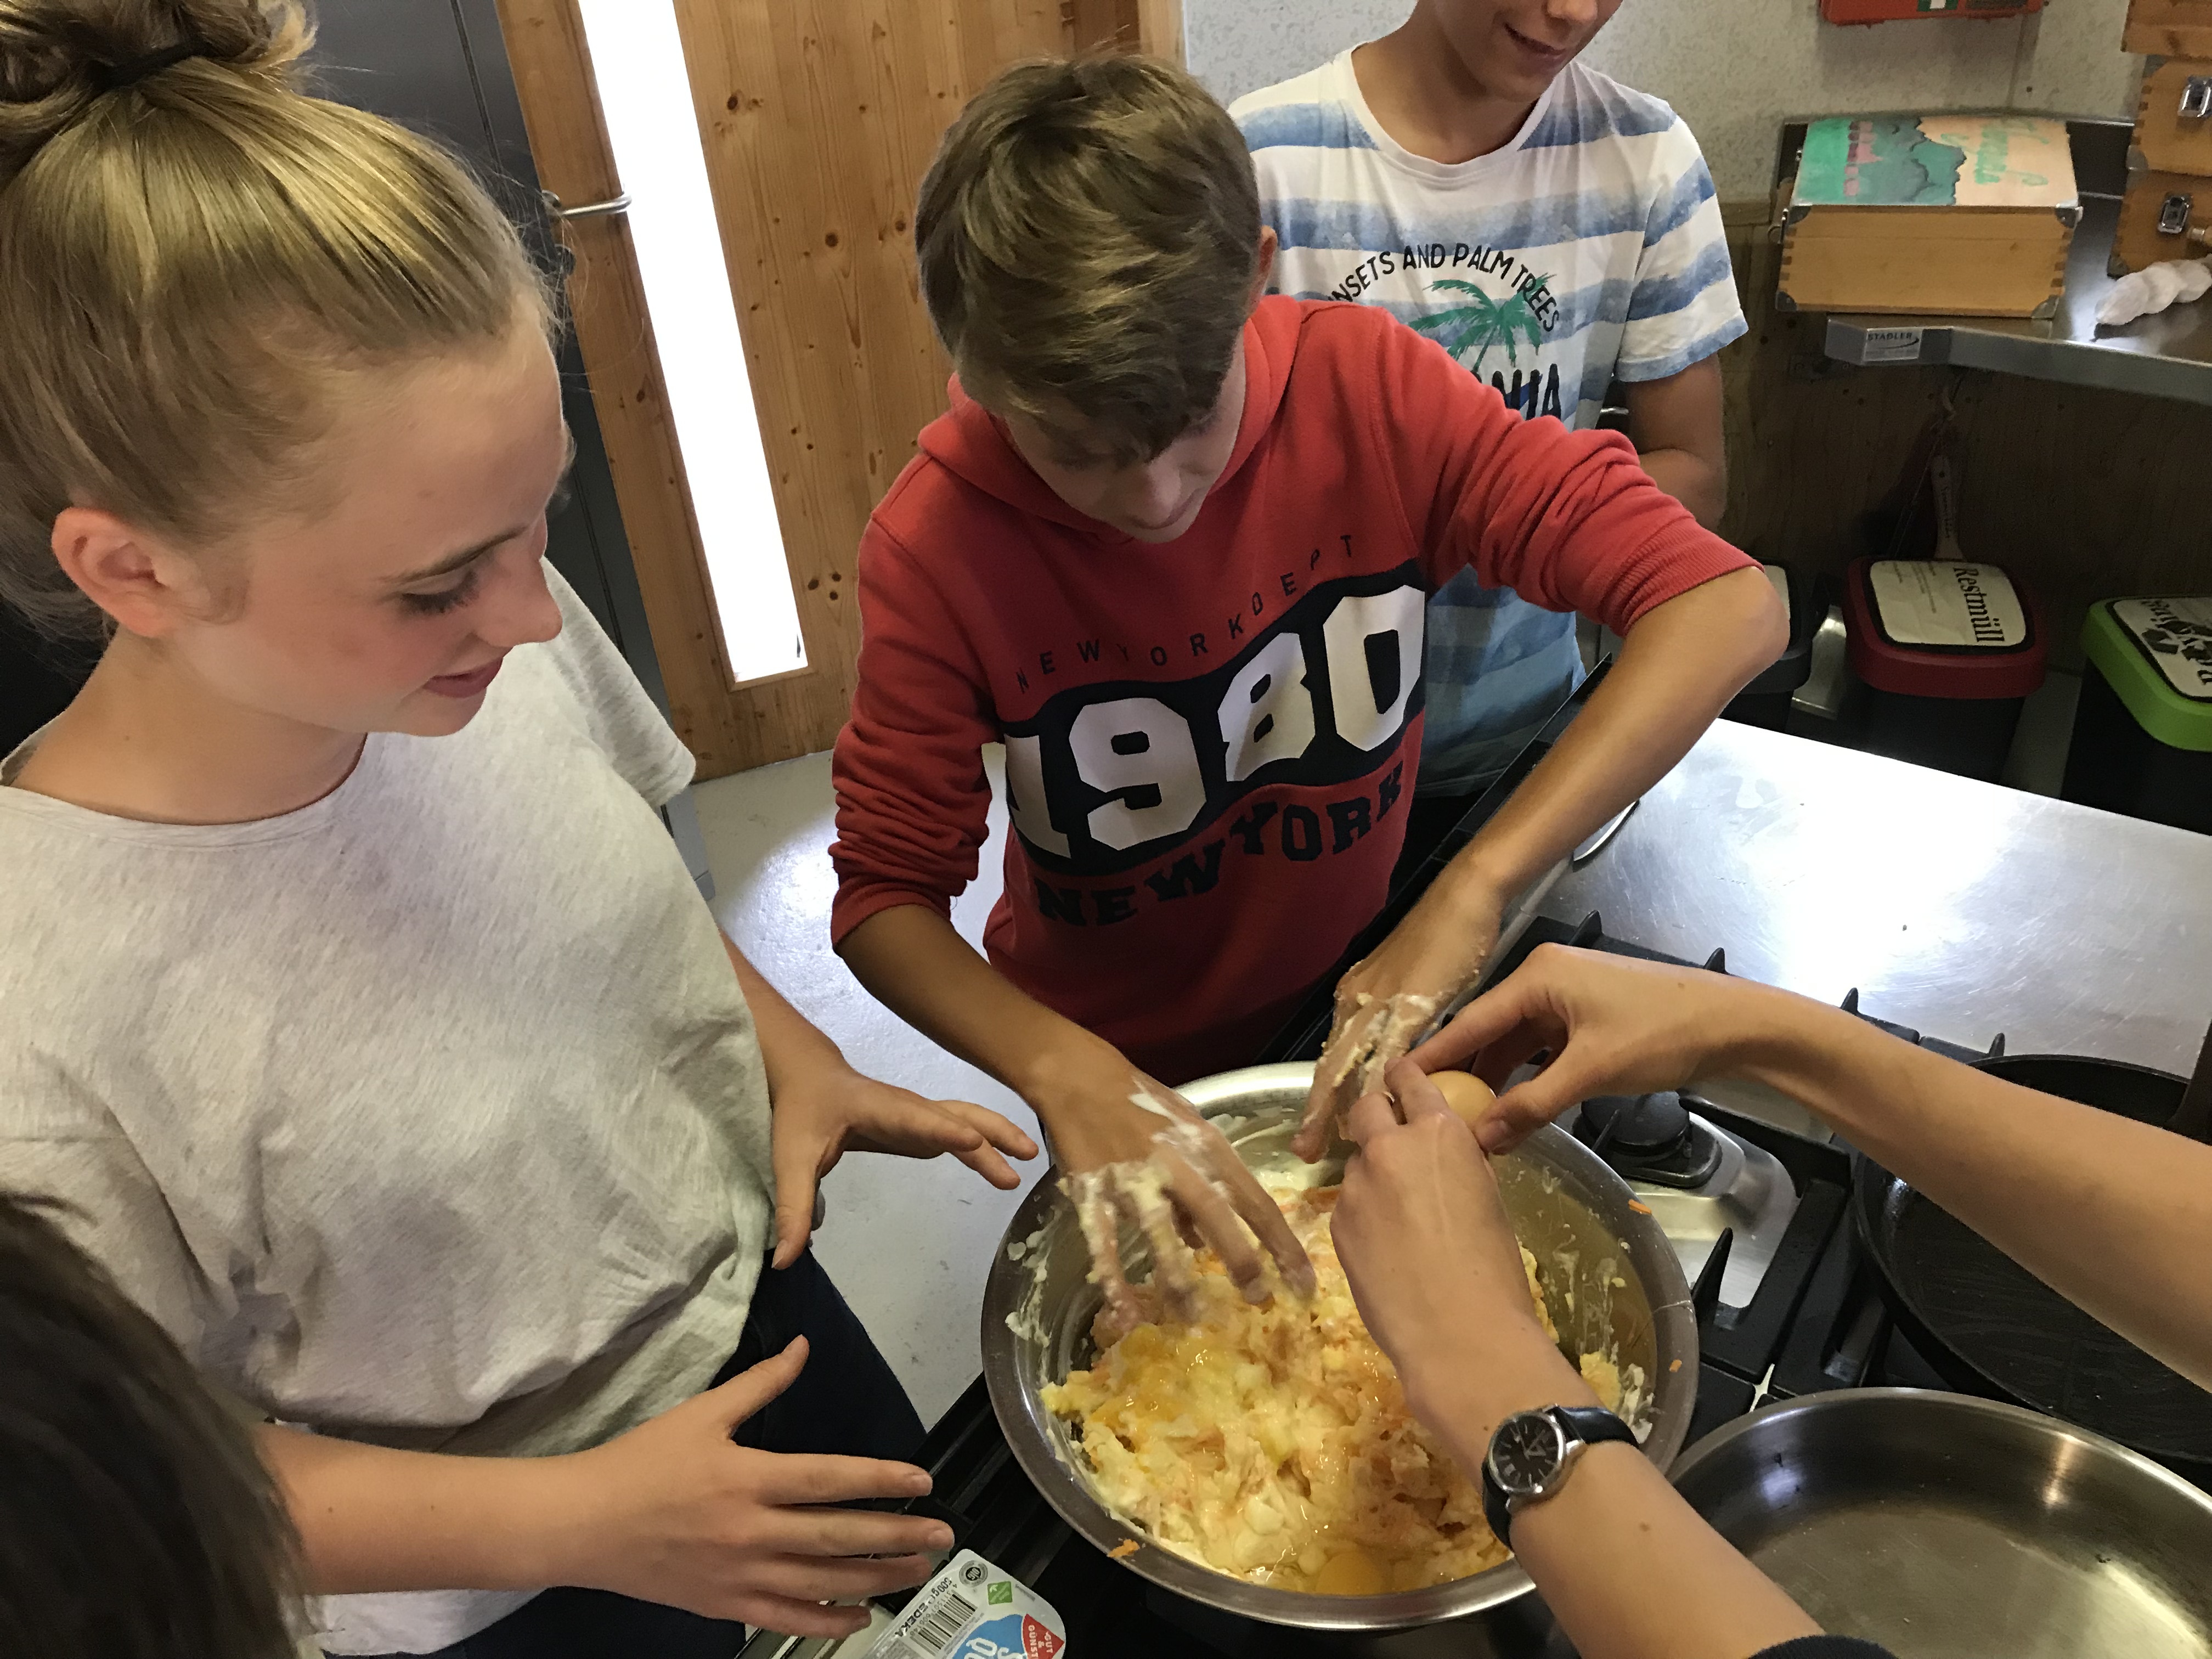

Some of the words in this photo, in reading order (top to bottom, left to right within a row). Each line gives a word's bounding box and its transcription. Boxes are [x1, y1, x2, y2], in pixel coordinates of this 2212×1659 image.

[1328, 251, 1395, 302] NSETS
[1403, 243, 1446, 270] AND
[1452, 242, 1515, 280] PALM
[1511, 264, 1559, 332] TREES
[1867, 332, 1912, 341] STADLER
[1953, 567, 2005, 642] Restmüll
[1004, 584, 1425, 860] 1980
[1034, 839, 1226, 927] NEW
[1229, 760, 1403, 861] YORK
[894, 1602, 929, 1637] EDEKA
[1044, 1633, 1053, 1654] GUT
